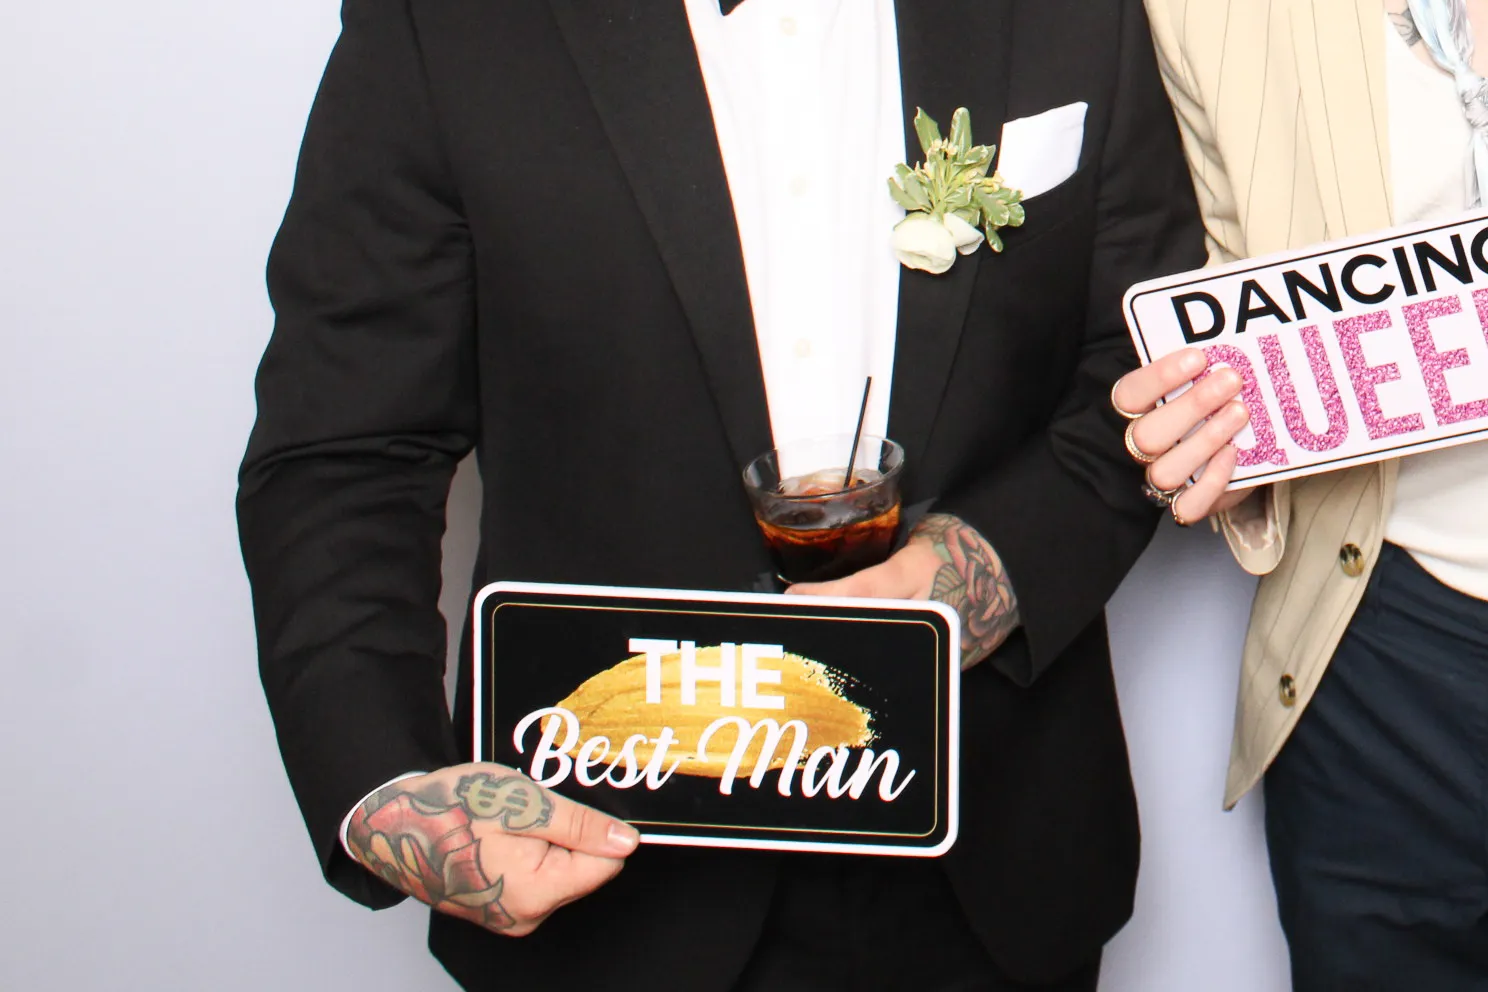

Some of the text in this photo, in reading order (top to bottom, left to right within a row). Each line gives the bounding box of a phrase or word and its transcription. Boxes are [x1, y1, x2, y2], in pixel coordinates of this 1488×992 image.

[628, 637, 786, 710] THE
[512, 706, 916, 802] Best Man
